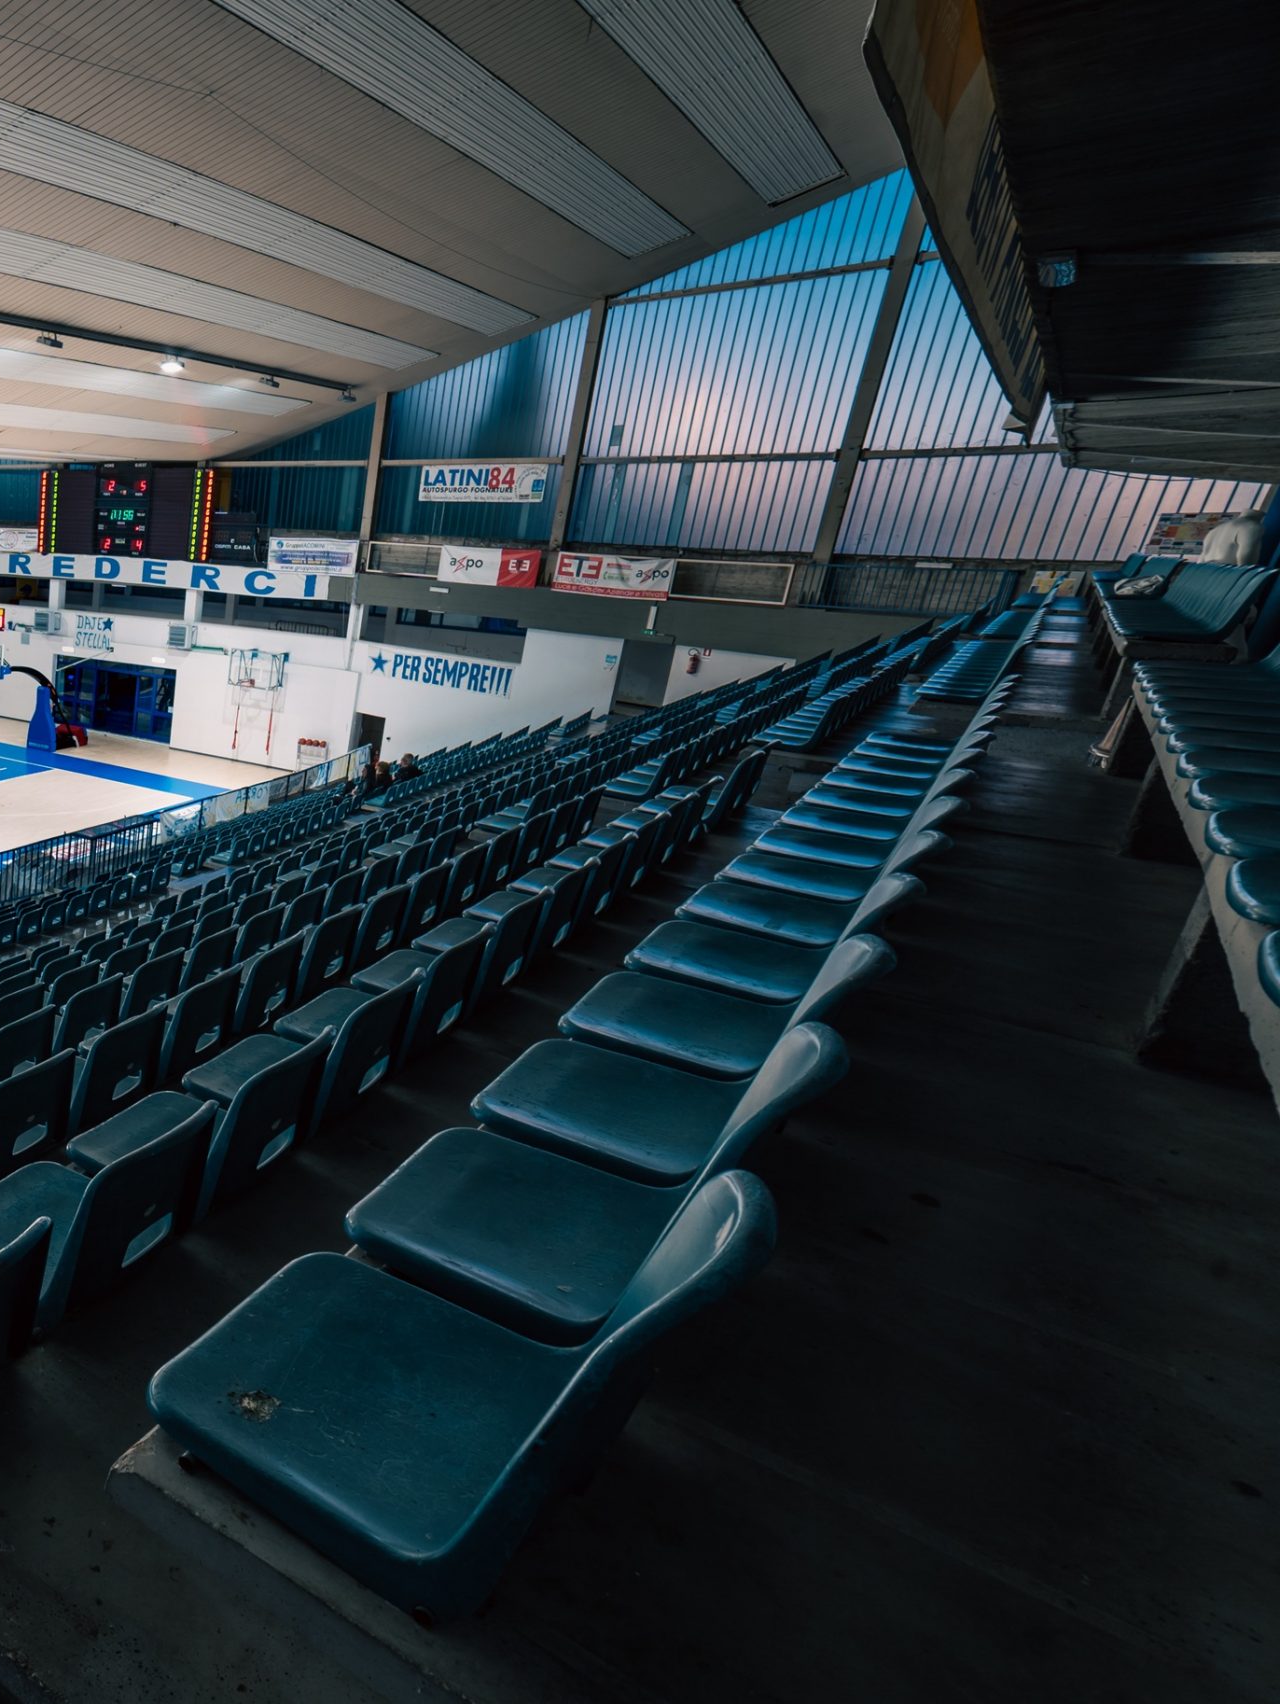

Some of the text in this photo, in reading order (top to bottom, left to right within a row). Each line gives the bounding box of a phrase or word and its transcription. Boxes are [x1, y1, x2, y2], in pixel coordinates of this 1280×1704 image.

[108, 480, 115, 492] 2
[140, 480, 147, 492] 5
[104, 538, 111, 549] 2
[135, 539, 143, 551] 4
[77, 614, 104, 631] DAJE
[392, 654, 513, 697] PER SEMPRE!!!
